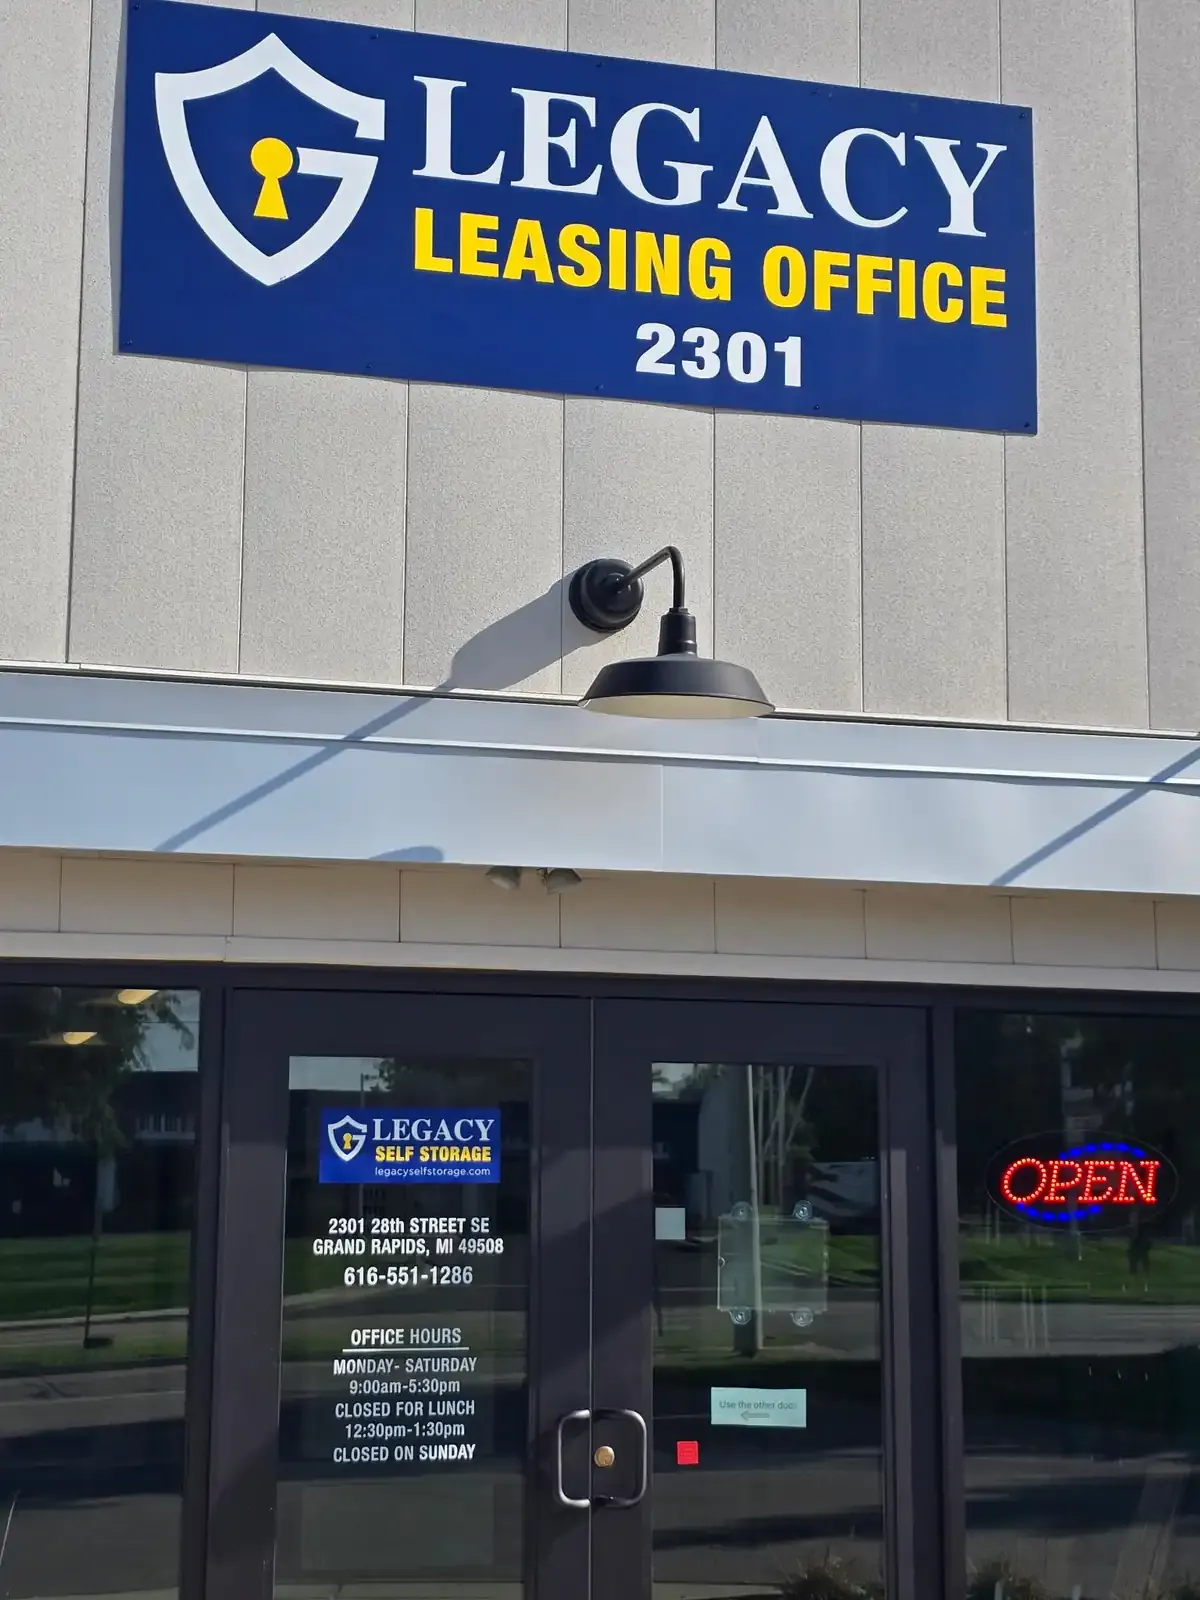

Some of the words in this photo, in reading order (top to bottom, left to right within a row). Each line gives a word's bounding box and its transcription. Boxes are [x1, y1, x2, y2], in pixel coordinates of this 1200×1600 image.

[412, 75, 1007, 239] LEGACY
[413, 207, 732, 303] LEASING
[762, 245, 1008, 328] OFFICE
[635, 322, 804, 389] 2301
[372, 1118, 495, 1142] LEGACY
[375, 1146, 414, 1162] SELF
[419, 1146, 492, 1162] STORAGE
[374, 1166, 491, 1177] legacyselfstorage.com
[1002, 1157, 1161, 1203] OPEN
[328, 1218, 365, 1235] 2301
[371, 1218, 405, 1234] 28th
[409, 1217, 466, 1234] STREET
[470, 1217, 490, 1233] SE
[313, 1239, 366, 1256] GRAND
[370, 1239, 430, 1257] RAPIDS,
[435, 1239, 454, 1255] MI
[458, 1238, 504, 1254] 49508
[343, 1265, 474, 1287] 616-551-1286
[350, 1328, 405, 1346] OFFICE
[409, 1328, 462, 1344] HOURS
[333, 1358, 400, 1376] MONDAY-
[405, 1357, 478, 1373] SATURDAY
[349, 1378, 461, 1396] 9:00am-5:30pm
[335, 1402, 391, 1419] CLOSED
[396, 1401, 424, 1417] FOR
[428, 1400, 476, 1416] LUNCH
[719, 1400, 736, 1410] Use
[738, 1400, 752, 1410] the
[753, 1400, 776, 1410] other
[345, 1421, 466, 1440] 12:30pm-1:30pm
[333, 1447, 389, 1463] CLOSED
[394, 1446, 415, 1461] ON
[419, 1443, 476, 1461] SUNDAY
